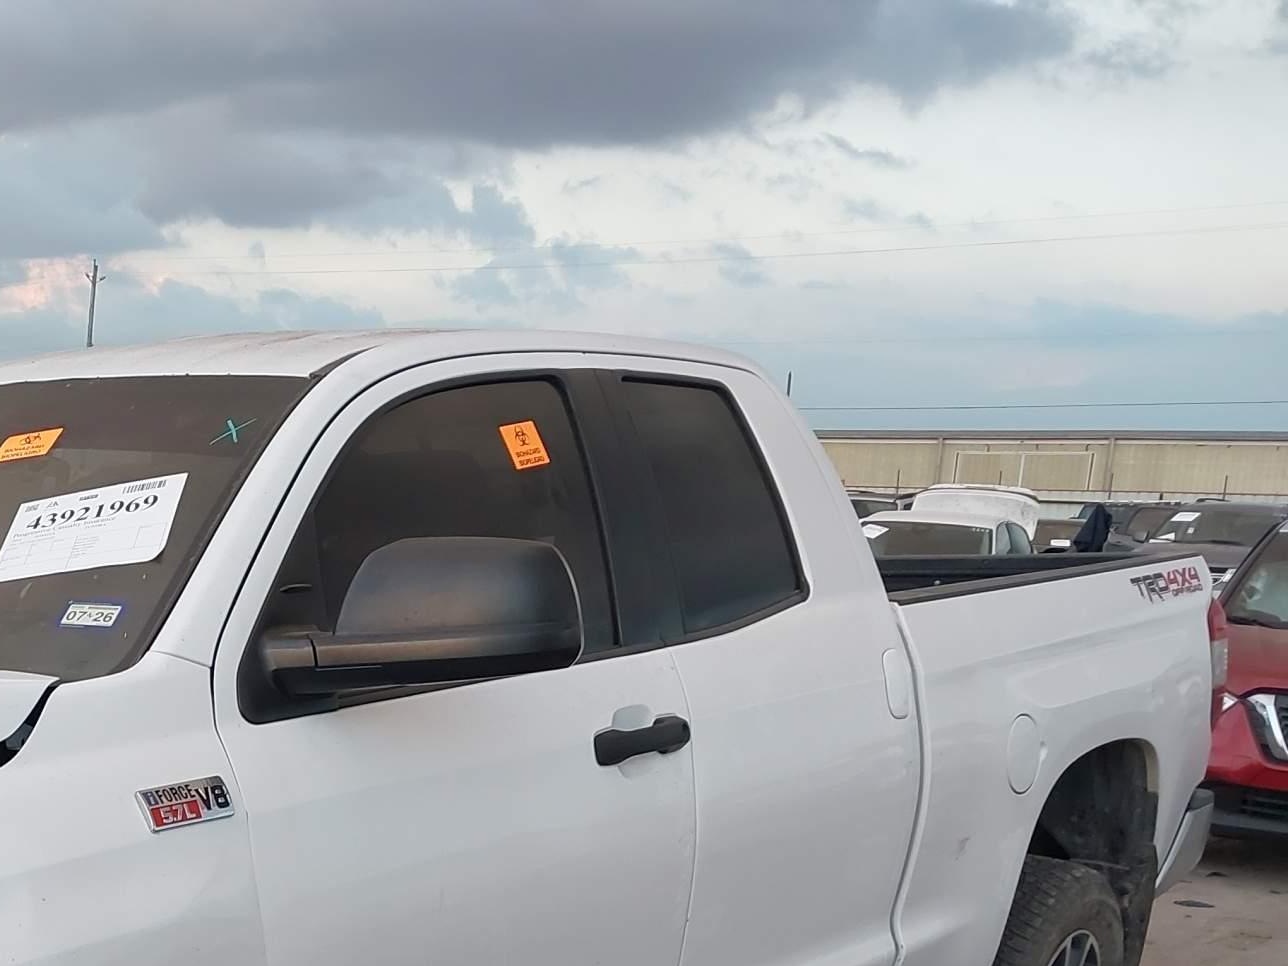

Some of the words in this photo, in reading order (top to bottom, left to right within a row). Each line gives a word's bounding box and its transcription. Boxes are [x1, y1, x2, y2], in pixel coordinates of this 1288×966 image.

[26, 495, 158, 530] 43921969
[1130, 572, 1169, 604] TRD
[66, 610, 88, 622] 07
[93, 611, 114, 623] 26
[194, 784, 230, 810] V8
[160, 804, 197, 823] 5.7L
